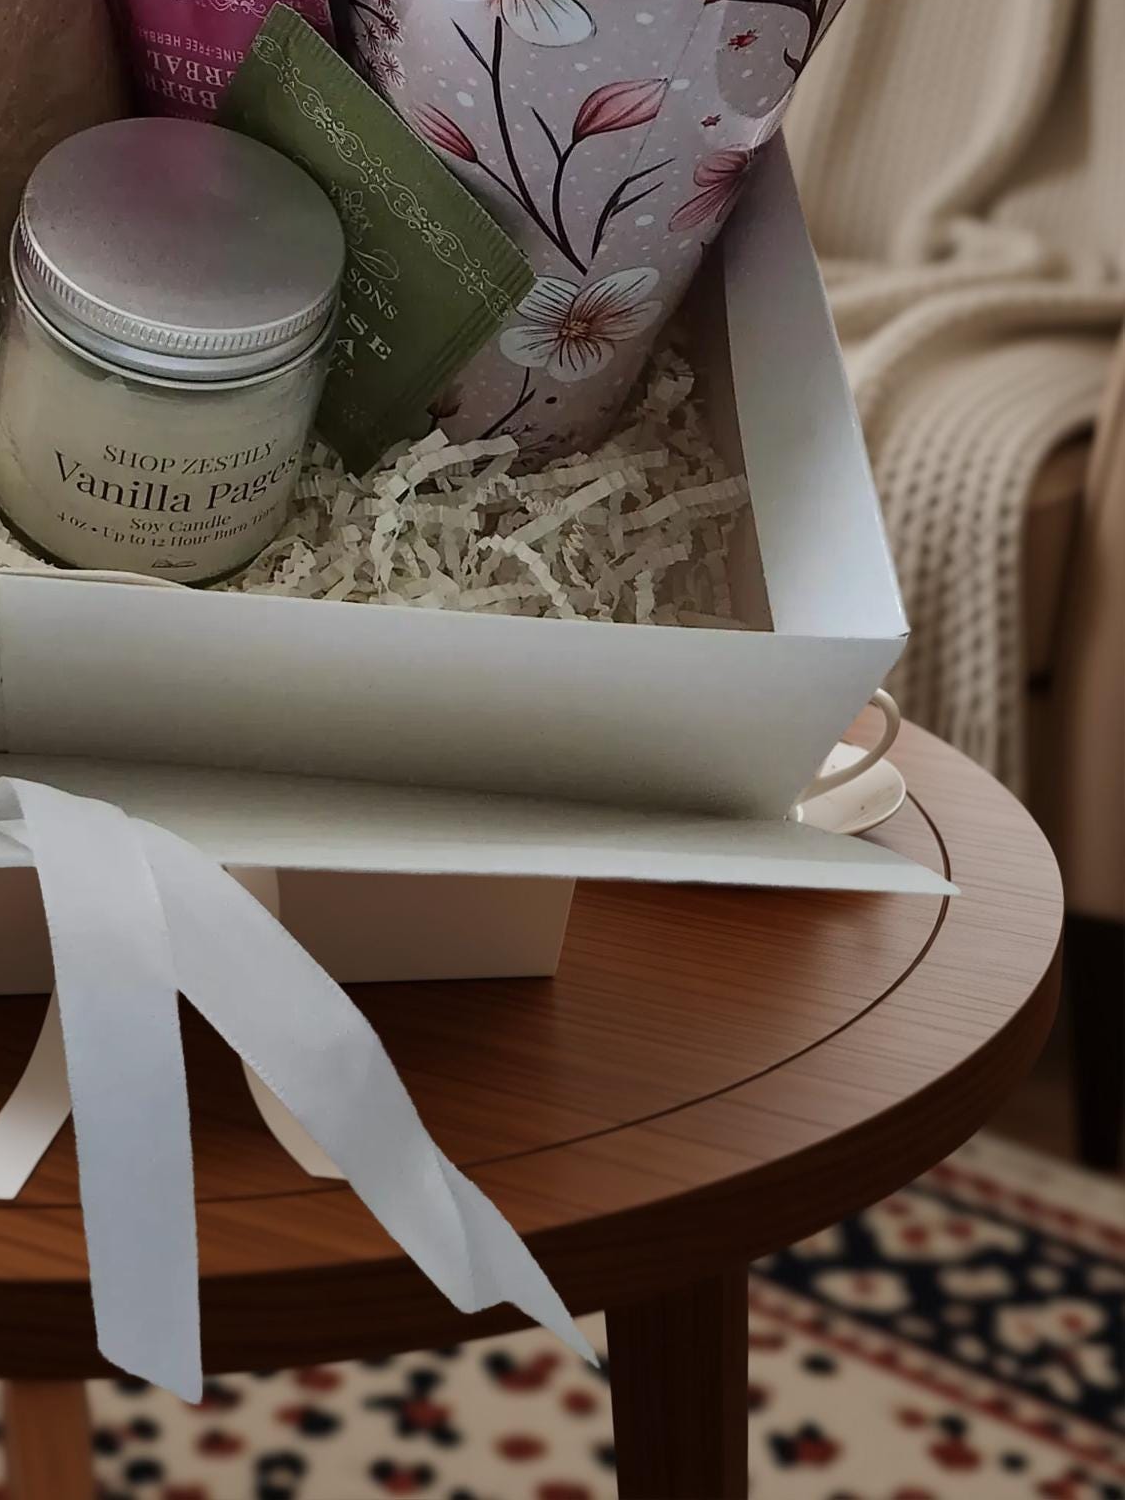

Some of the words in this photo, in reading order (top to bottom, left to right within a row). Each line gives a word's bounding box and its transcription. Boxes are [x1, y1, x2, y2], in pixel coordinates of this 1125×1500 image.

[347, 266, 398, 321] SONS
[462, 263, 486, 291] TEA
[103, 443, 176, 474] SHOP
[181, 438, 277, 475] ZESTILY
[52, 448, 192, 513] Vanilla
[207, 449, 299, 510] Pages
[56, 511, 68, 524] 4
[69, 516, 88, 530] oz
[103, 525, 126, 543] Up
[130, 532, 146, 546] to
[151, 537, 166, 548] 12
[170, 534, 211, 548] Hour
[214, 523, 248, 541] Burn
[129, 516, 162, 534] Soy
[169, 513, 232, 534] Candle
